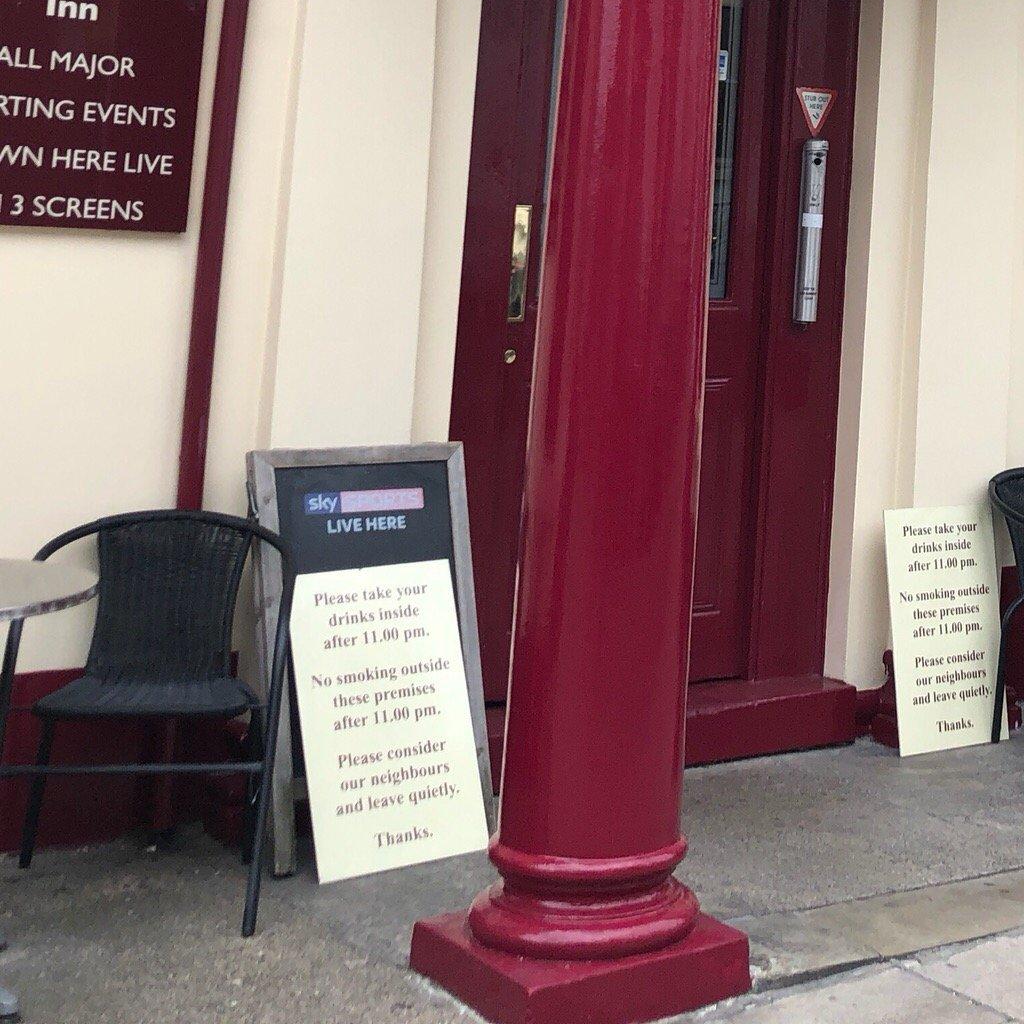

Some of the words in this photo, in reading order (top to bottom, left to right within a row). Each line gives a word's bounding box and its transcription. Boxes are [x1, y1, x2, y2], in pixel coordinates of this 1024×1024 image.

[0, 45, 43, 70] ALL
[50, 49, 136, 81] MAJOR
[83, 101, 177, 129] EVENTS
[51, 147, 117, 172] HERE
[124, 152, 174, 176] LIVE
[10, 193, 25, 216] 3
[32, 194, 145, 222] SCREENS
[308, 495, 338, 513] sky
[326, 518, 363, 535] LIVE
[365, 515, 407, 531] HERE
[902, 525, 932, 537] Please
[934, 523, 954, 535] take
[956, 522, 977, 536] your
[911, 542, 943, 554] drinks
[944, 539, 972, 552] inside
[908, 561, 931, 572] after
[934, 557, 958, 570] 11.00
[960, 558, 978, 570] pm.
[314, 591, 358, 608] Please
[362, 586, 392, 602] take
[396, 584, 428, 607] your
[899, 591, 913, 603] No
[915, 588, 956, 601] smoking
[957, 583, 991, 597] outside
[328, 607, 375, 627] drinks
[378, 604, 420, 621] inside
[913, 608, 937, 620] these
[939, 603, 980, 620] premises
[323, 634, 358, 650] after
[363, 630, 399, 646] 11.00
[403, 627, 430, 641] pm.
[913, 626, 935, 638] after
[938, 621, 963, 635] 11.00
[965, 621, 983, 635] pm.
[915, 656, 944, 669] Please
[946, 649, 986, 664] consider
[311, 674, 333, 690] No
[336, 667, 398, 685] smoking
[401, 658, 451, 676] outside
[916, 677, 933, 687] our
[935, 667, 987, 685] neighbours
[333, 692, 370, 708] these
[374, 683, 436, 706] premises
[912, 694, 931, 706] and
[933, 690, 957, 703] leave
[959, 684, 993, 702] quietly.
[333, 714, 368, 731] after
[373, 706, 410, 724] 11.00
[414, 703, 441, 721] pm.
[936, 717, 974, 733] Thanks.
[338, 752, 383, 769] Please
[387, 739, 447, 760] consider
[340, 779, 366, 792] our
[370, 762, 451, 787] neighbours
[336, 798, 364, 816] and
[368, 793, 405, 810] leave
[408, 781, 461, 806] quietly.
[374, 826, 434, 849] Thanks.
